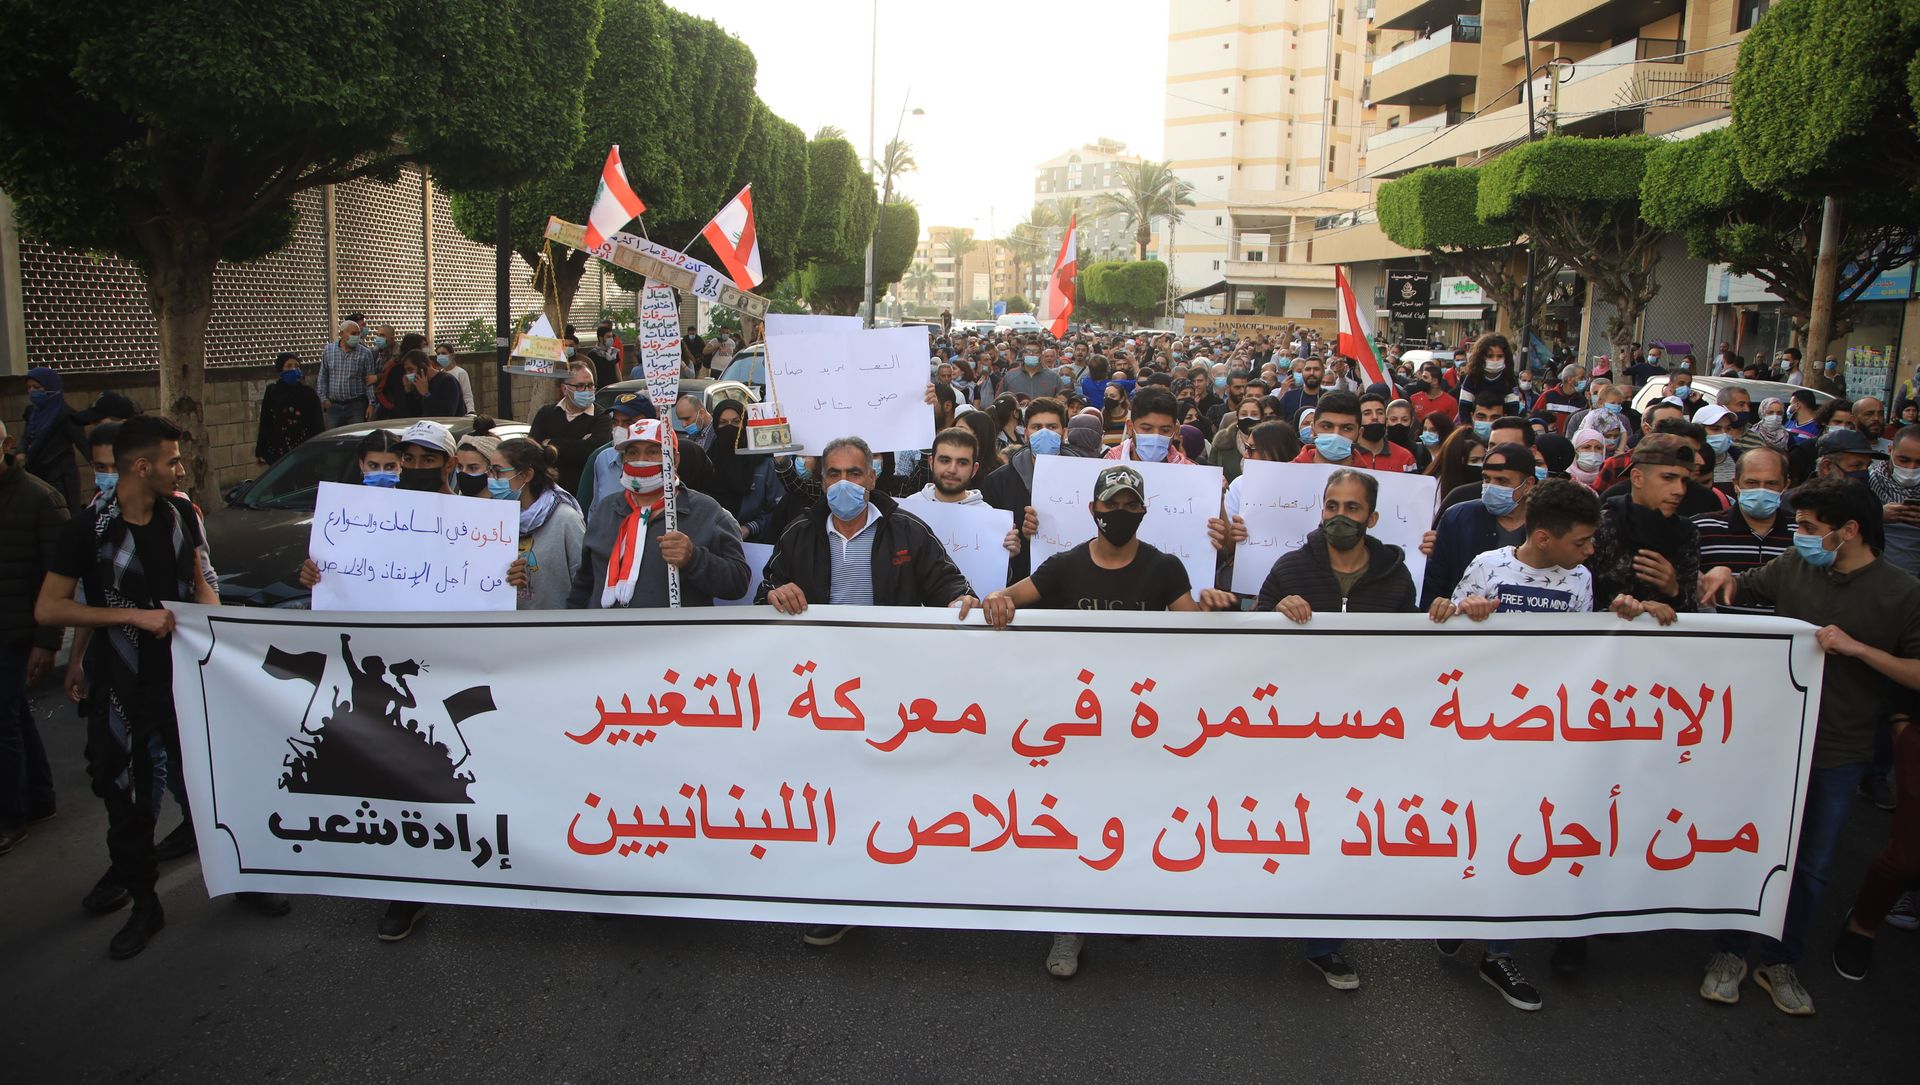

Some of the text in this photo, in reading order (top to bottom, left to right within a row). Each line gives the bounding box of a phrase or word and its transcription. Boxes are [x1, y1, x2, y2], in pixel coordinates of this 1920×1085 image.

[324, 507, 512, 548] باقون في الساحات والشوارع
[435, 560, 469, 594] أجل
[1500, 593, 1569, 611] FREE YOUR MIND
[566, 661, 1732, 766] الإنتفاضة مستمرة في معركة التغيير
[268, 800, 512, 870] إرادة شعب
[568, 784, 1758, 878] من أجل إنقاذ لبنان وخلاص اللبنانيين
